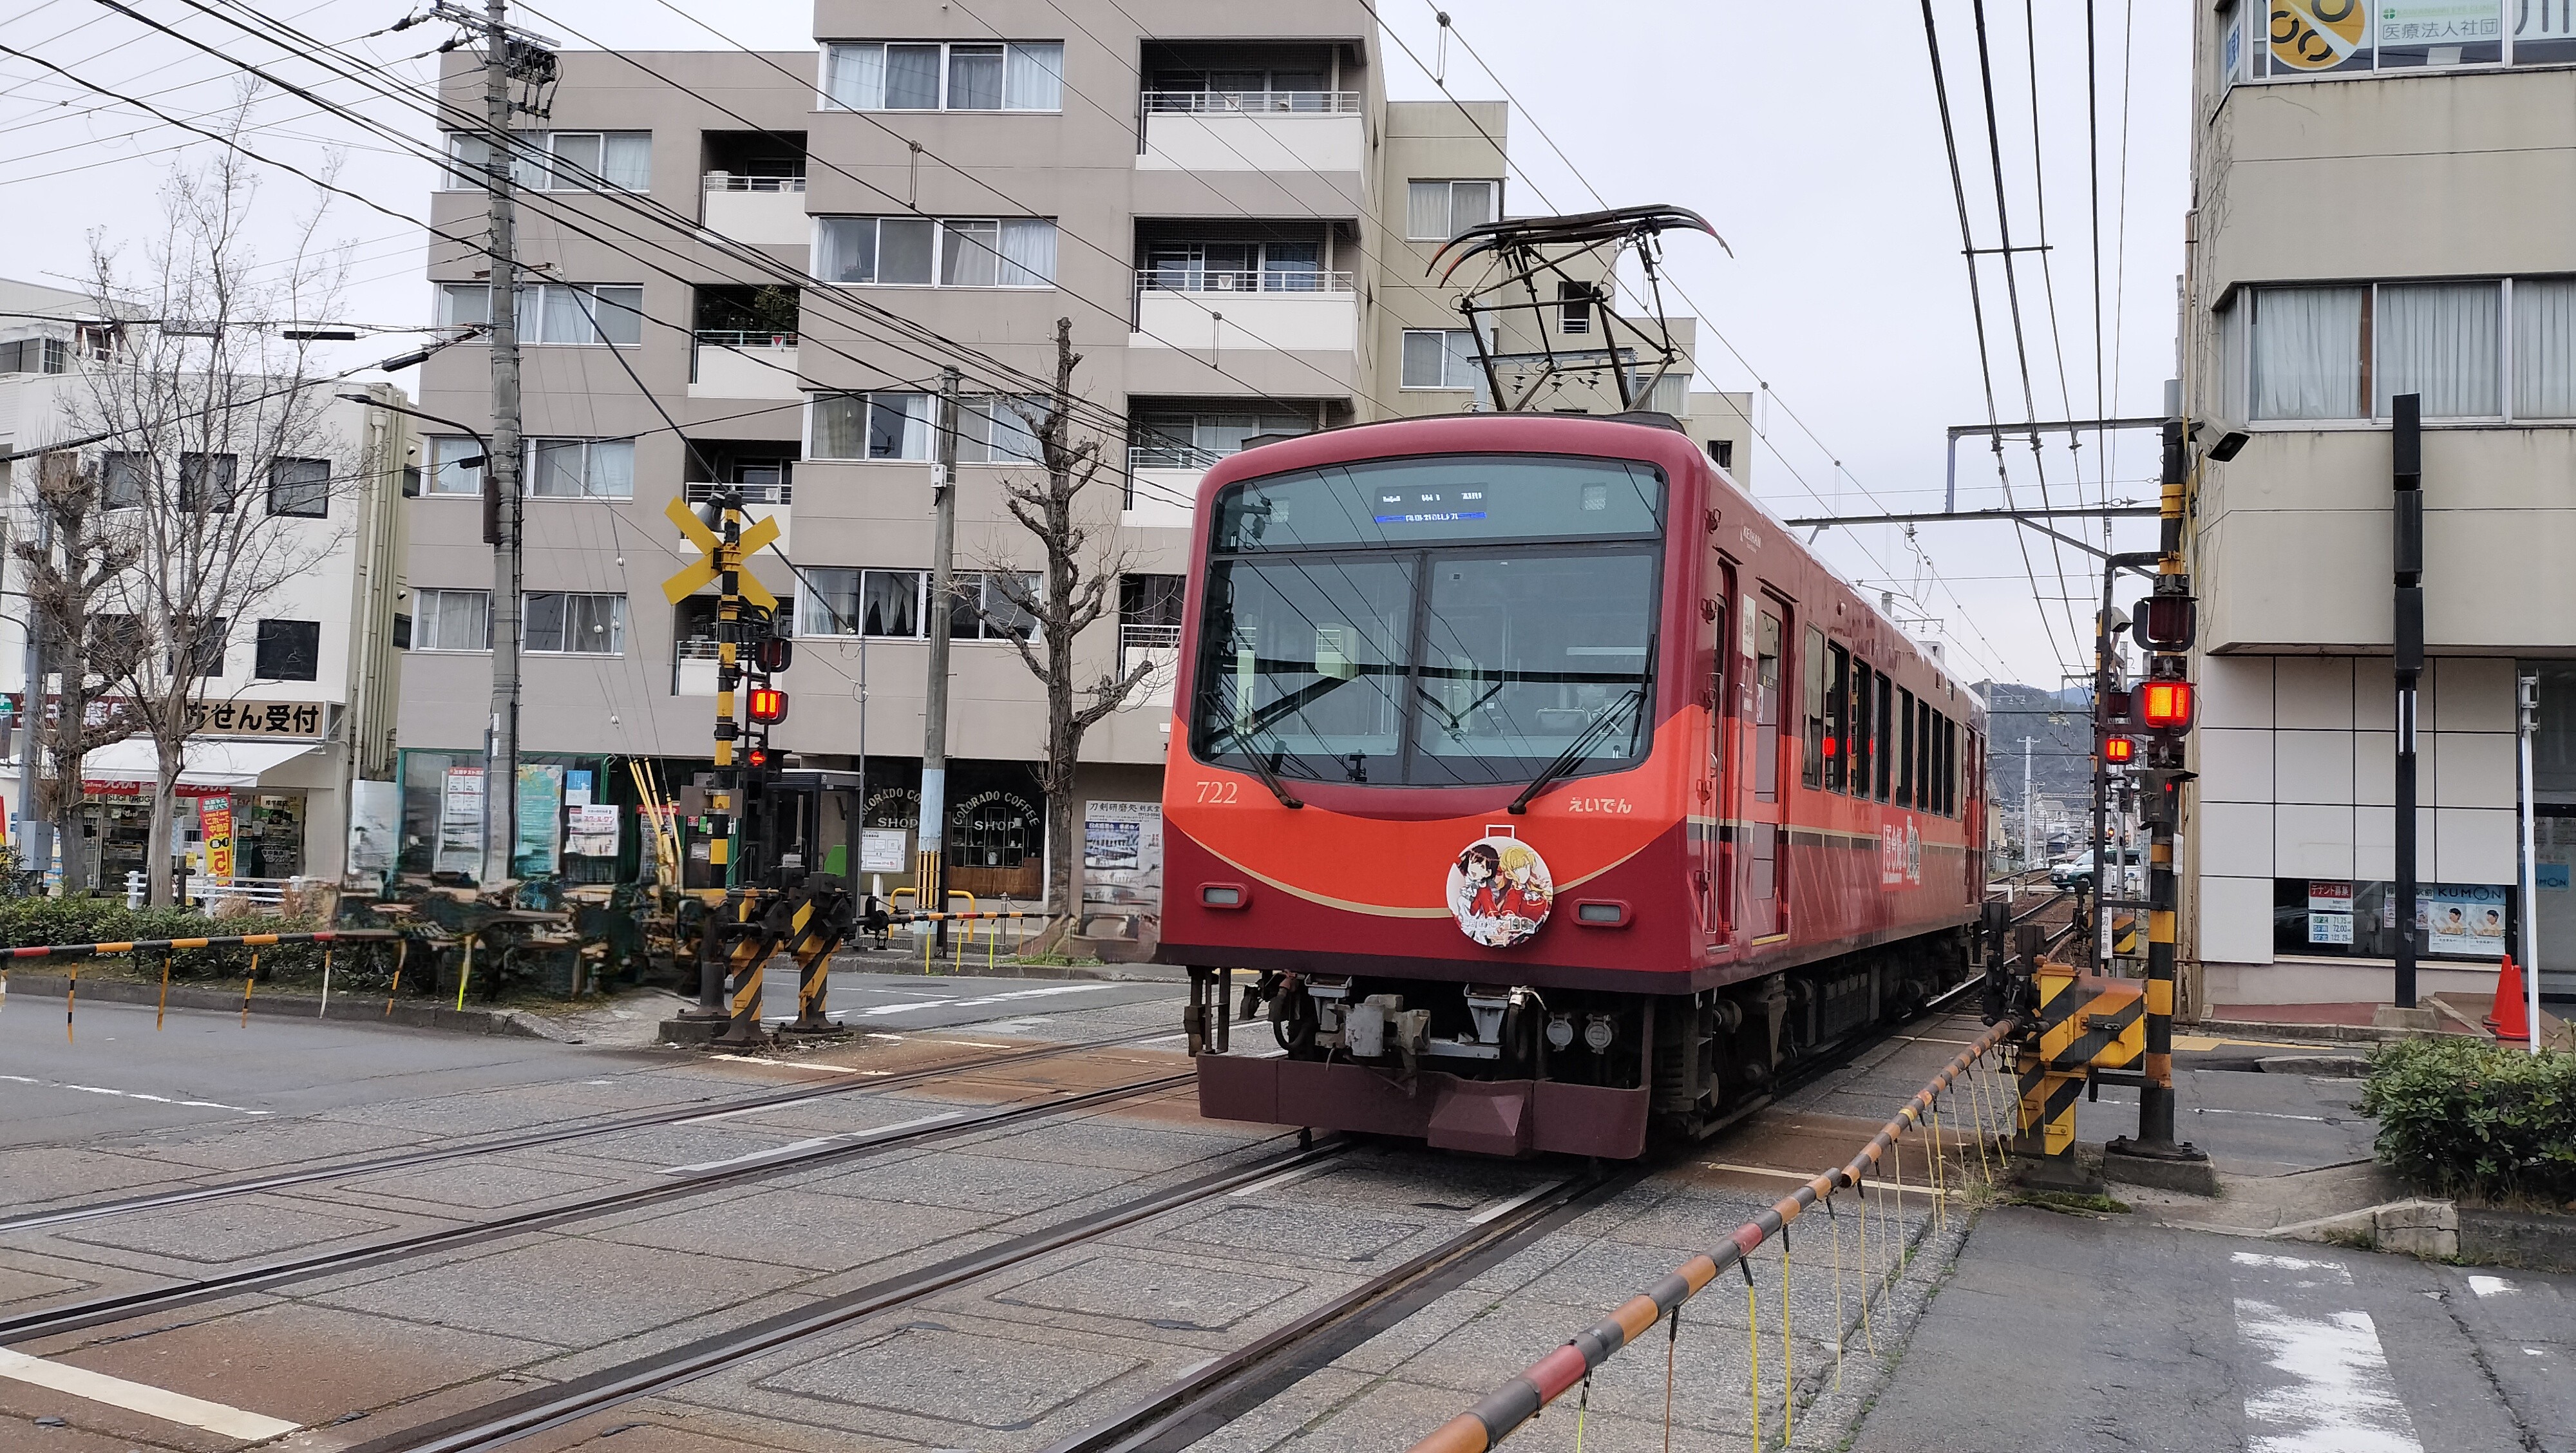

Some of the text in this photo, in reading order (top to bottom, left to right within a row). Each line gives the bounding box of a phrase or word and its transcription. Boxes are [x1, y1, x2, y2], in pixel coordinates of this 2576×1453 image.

[2383, 19, 2498, 40] 医療法人社団
[1197, 781, 1238, 804] 722
[954, 790, 1040, 827] COLORADO COFFEE
[1089, 802, 1137, 812] 刀剣研磨処
[1568, 797, 1632, 814] えいでん
[878, 817, 918, 828] SHOP
[974, 821, 1016, 831] SHOP
[2311, 885, 2349, 896] テナント募集
[2438, 886, 2501, 900] KUMON
